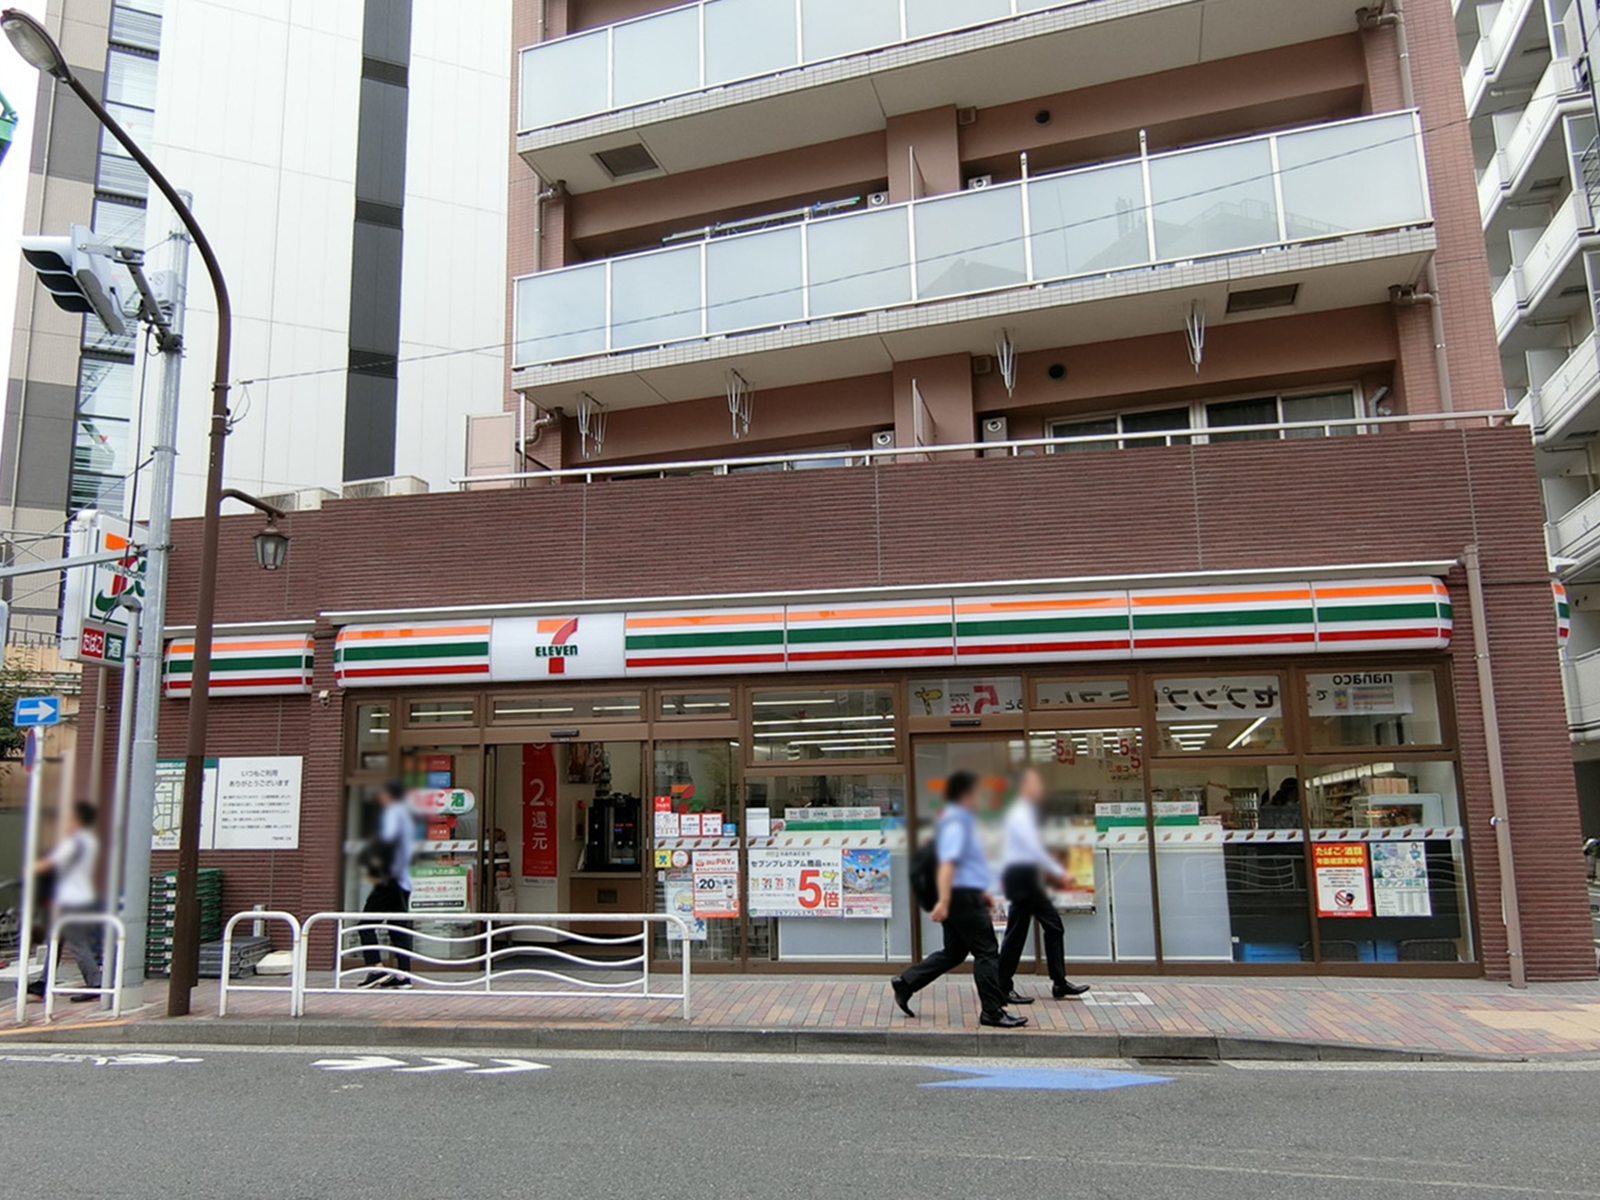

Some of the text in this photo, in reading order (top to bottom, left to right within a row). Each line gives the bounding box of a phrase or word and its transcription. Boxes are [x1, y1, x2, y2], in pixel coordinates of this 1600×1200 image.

[83, 632, 103, 654] たばこ
[107, 637, 122, 658] 酒
[532, 811, 548, 850] 還元
[798, 870, 822, 908] 5
